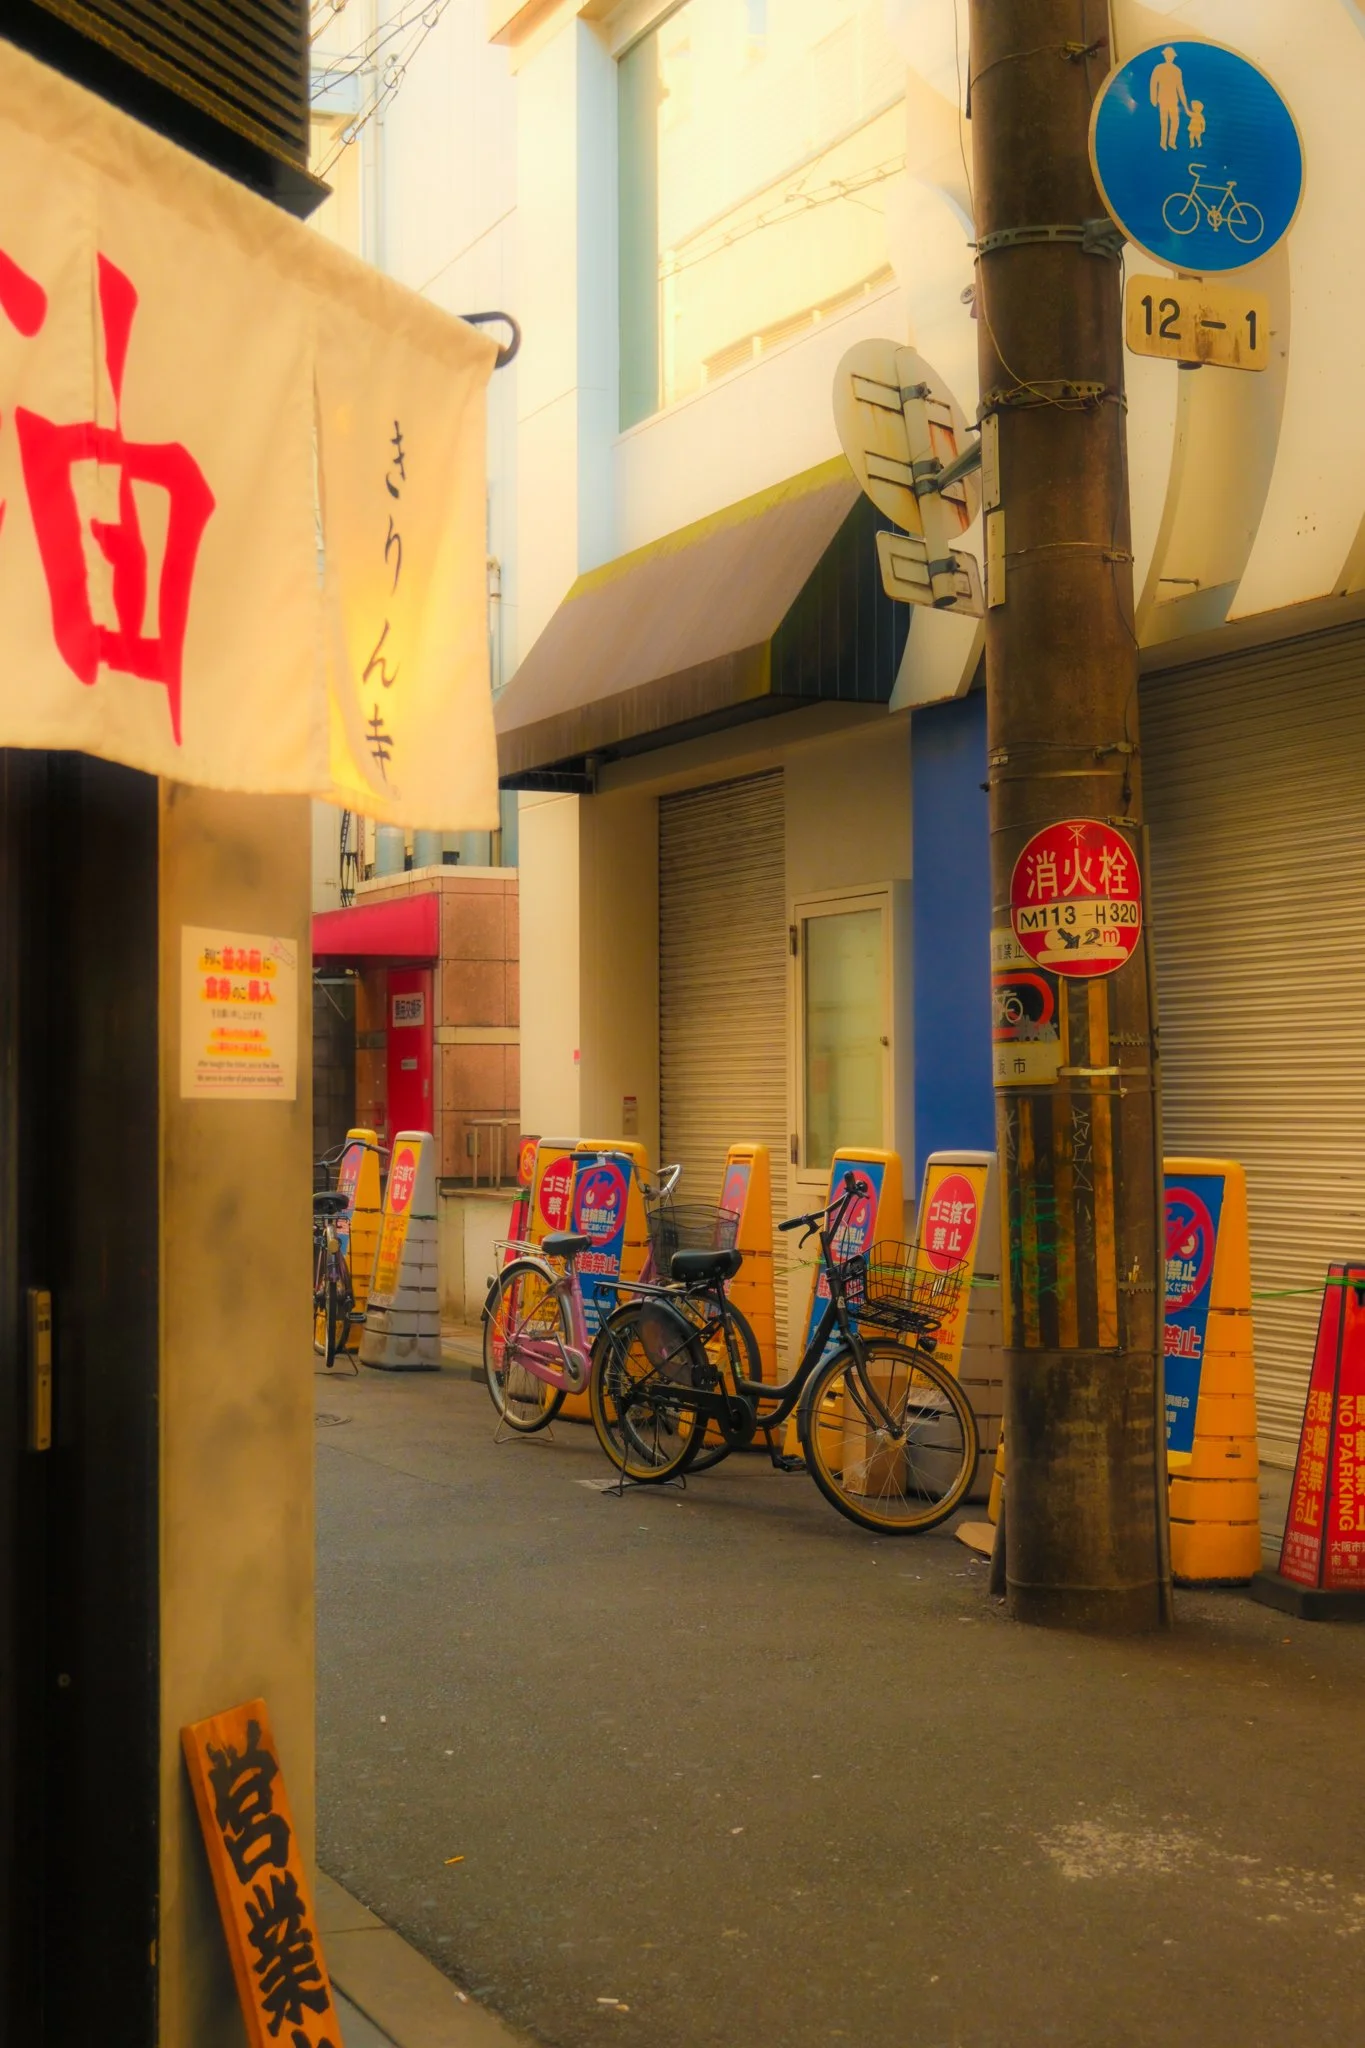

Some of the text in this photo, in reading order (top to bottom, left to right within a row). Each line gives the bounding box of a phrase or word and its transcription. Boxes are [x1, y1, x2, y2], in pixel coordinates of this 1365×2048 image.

[362, 420, 407, 783] きりん寺
[1026, 845, 1129, 900] 消火栓
[930, 1200, 975, 1225] ゴミ捨て
[932, 1227, 962, 1252] 禁止
[1294, 1390, 1318, 1522] NO PARKING
[1339, 1395, 1355, 1531] NO PARKING
[205, 1719, 336, 2048] 営業
